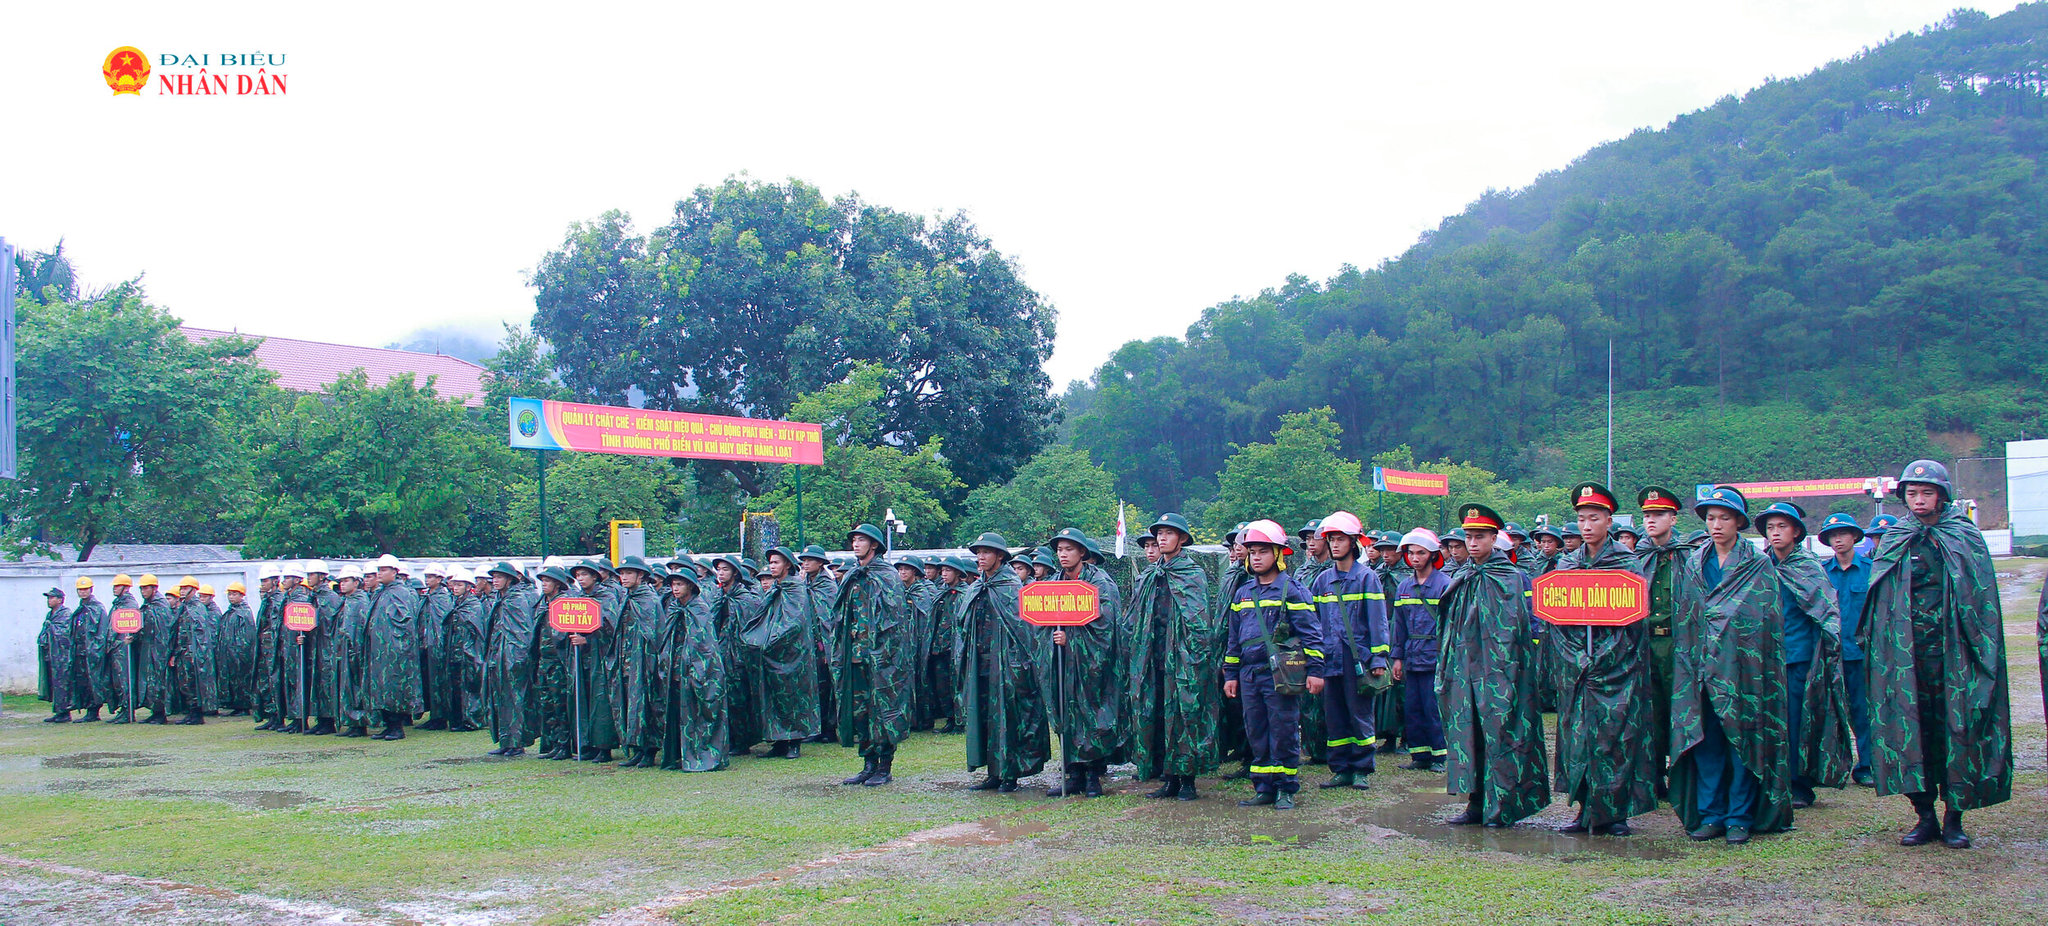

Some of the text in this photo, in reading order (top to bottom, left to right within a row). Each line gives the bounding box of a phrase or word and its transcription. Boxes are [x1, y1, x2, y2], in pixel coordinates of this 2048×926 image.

[562, 407, 583, 425] QUẢN
[585, 411, 594, 426] LÝ
[595, 412, 614, 431] CHẶT
[655, 417, 672, 432] SOÁT
[674, 418, 690, 436] HIỆU
[691, 417, 704, 435] QUẢ
[710, 419, 723, 435] CHỦ
[742, 424, 758, 438] PHÁT
[759, 425, 774, 441] HIỆN
[788, 427, 794, 441] LÝ
[796, 430, 806, 444] KỊP
[601, 431, 621, 448] TÌNH
[623, 432, 652, 450] HUỐNG
[692, 438, 703, 453] VŨ
[705, 439, 718, 453] KHÍ
[736, 441, 753, 458] DIỆT
[754, 442, 774, 457] HÀNG
[775, 445, 793, 460] LOẠT
[562, 602, 587, 612] BỘ PHẬN
[1023, 591, 1093, 612] PHÒNG CHÁY CHỮA CHÁY
[1543, 582, 1635, 610] CÔNG AN, DÂN QUÂN
[576, 611, 593, 625] TẨY
